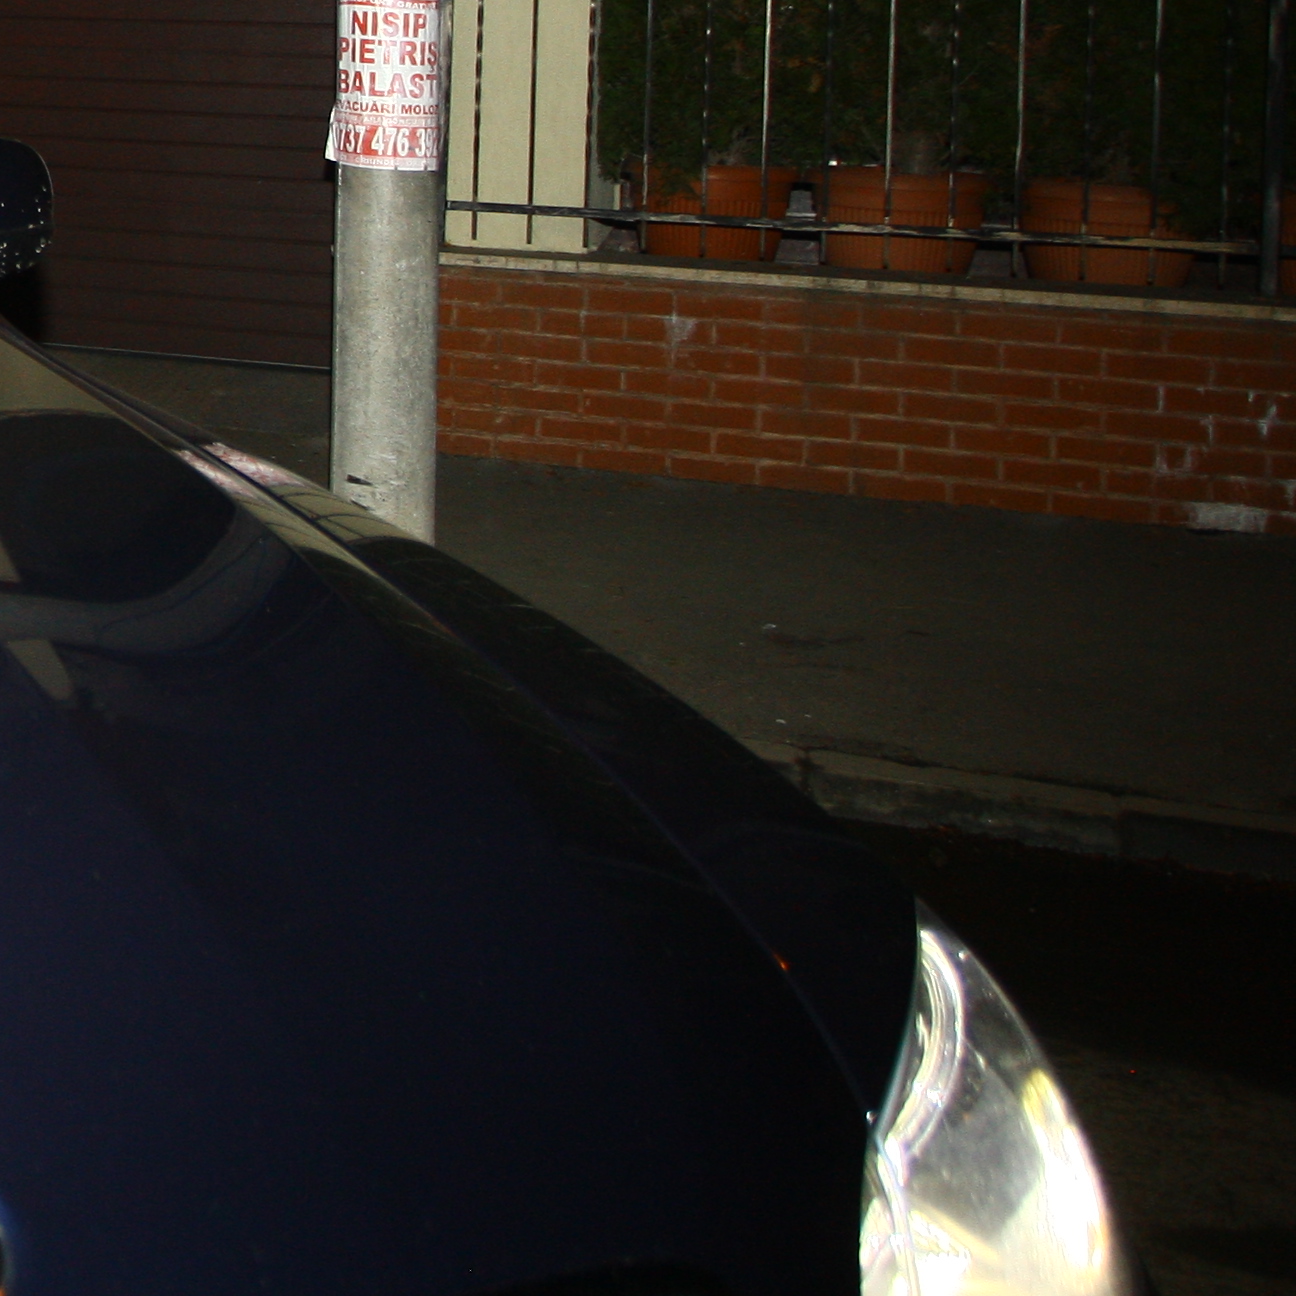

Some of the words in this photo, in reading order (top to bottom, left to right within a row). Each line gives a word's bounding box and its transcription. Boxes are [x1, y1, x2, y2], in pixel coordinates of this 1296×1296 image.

[352, 10, 427, 38] NISIP
[338, 70, 437, 99] BALAST
[371, 126, 410, 156] 476
